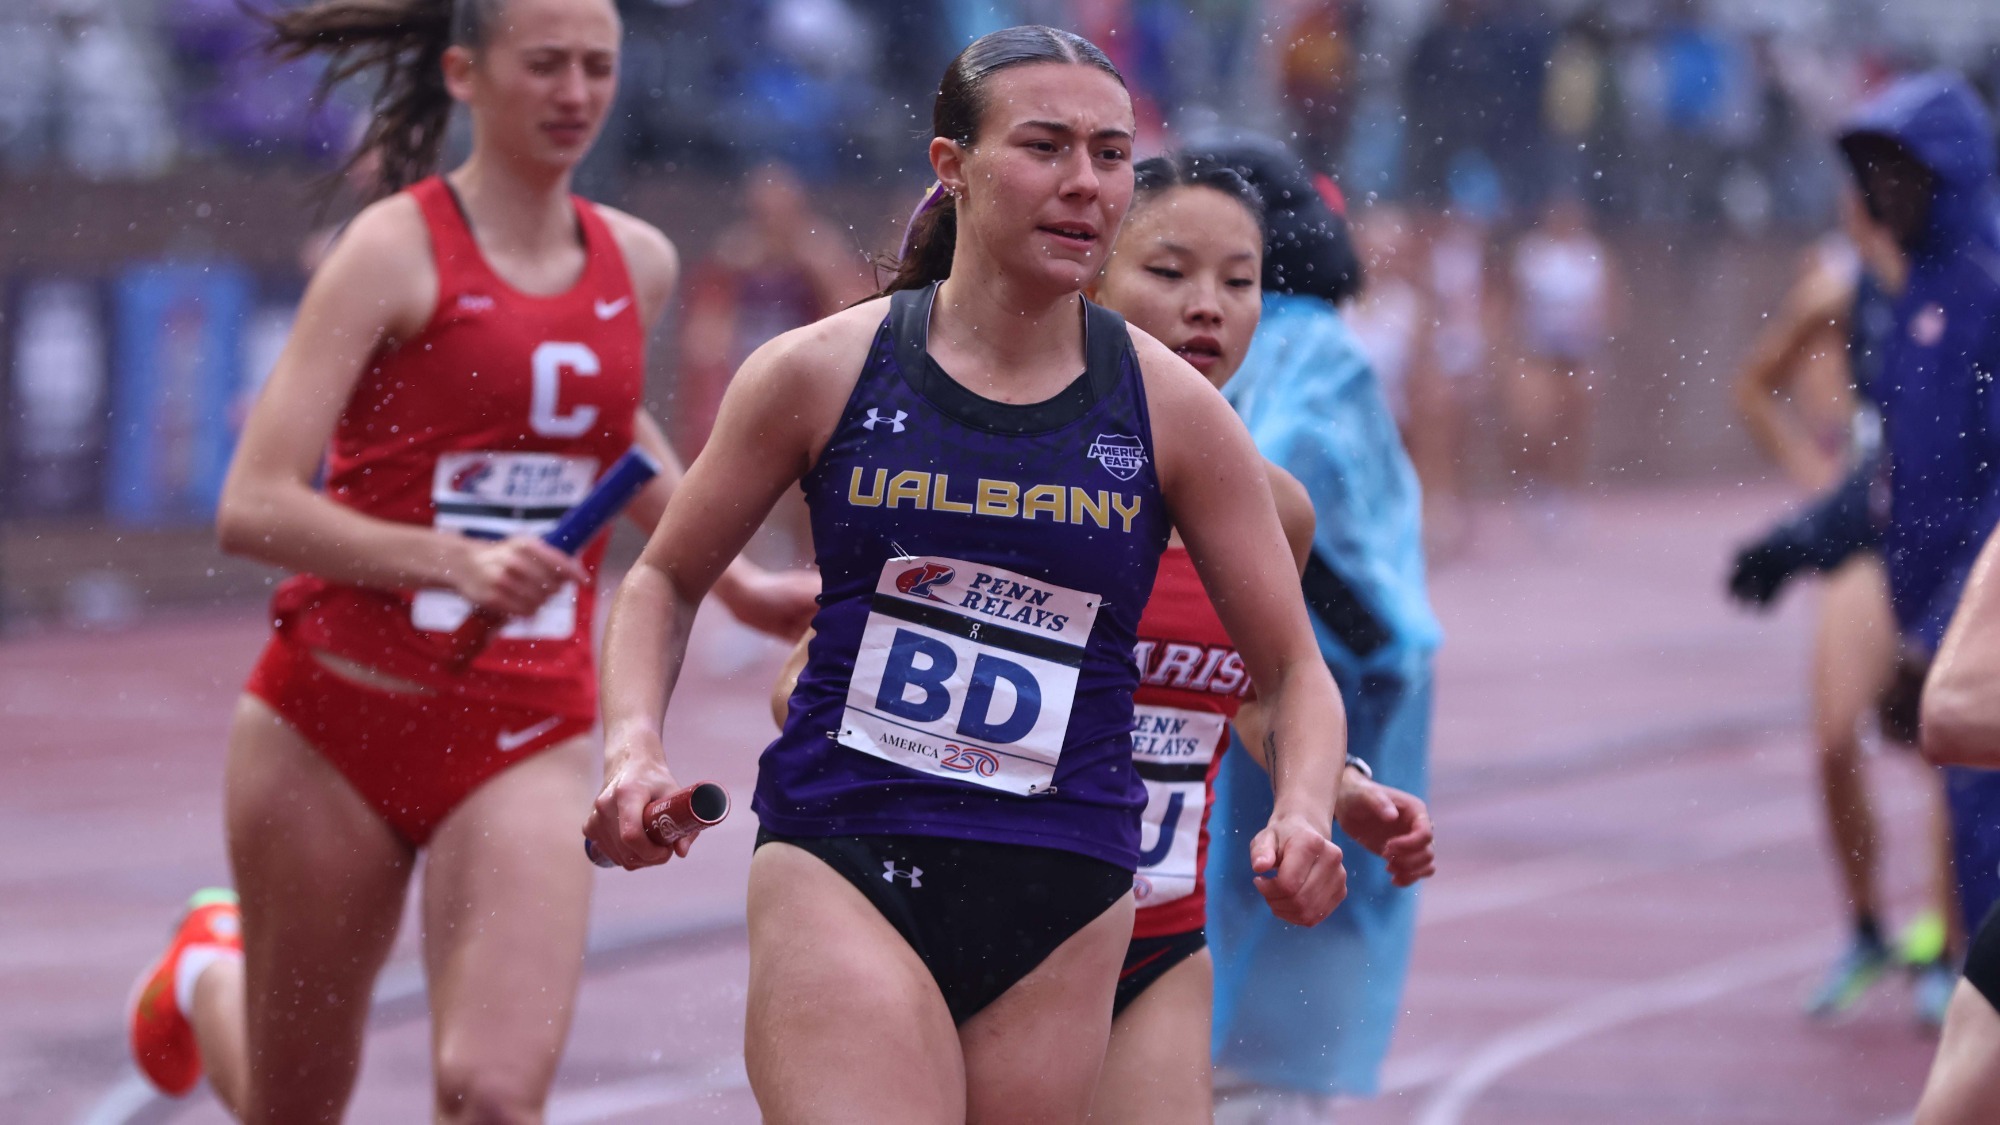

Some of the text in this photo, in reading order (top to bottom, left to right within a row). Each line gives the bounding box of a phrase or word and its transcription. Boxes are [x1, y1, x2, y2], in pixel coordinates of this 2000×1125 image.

[531, 341, 600, 437] C
[1104, 456, 1139, 468] EAST
[848, 466, 1142, 533] UALBANY
[969, 572, 1053, 606] PENN
[959, 590, 1069, 632] RELAYS
[875, 628, 1042, 744] BD
[1133, 641, 1251, 697] ARIS
[1133, 715, 1188, 735] ENN
[880, 733, 939, 759] AMERICA
[1132, 737, 1199, 756] ELAYS
